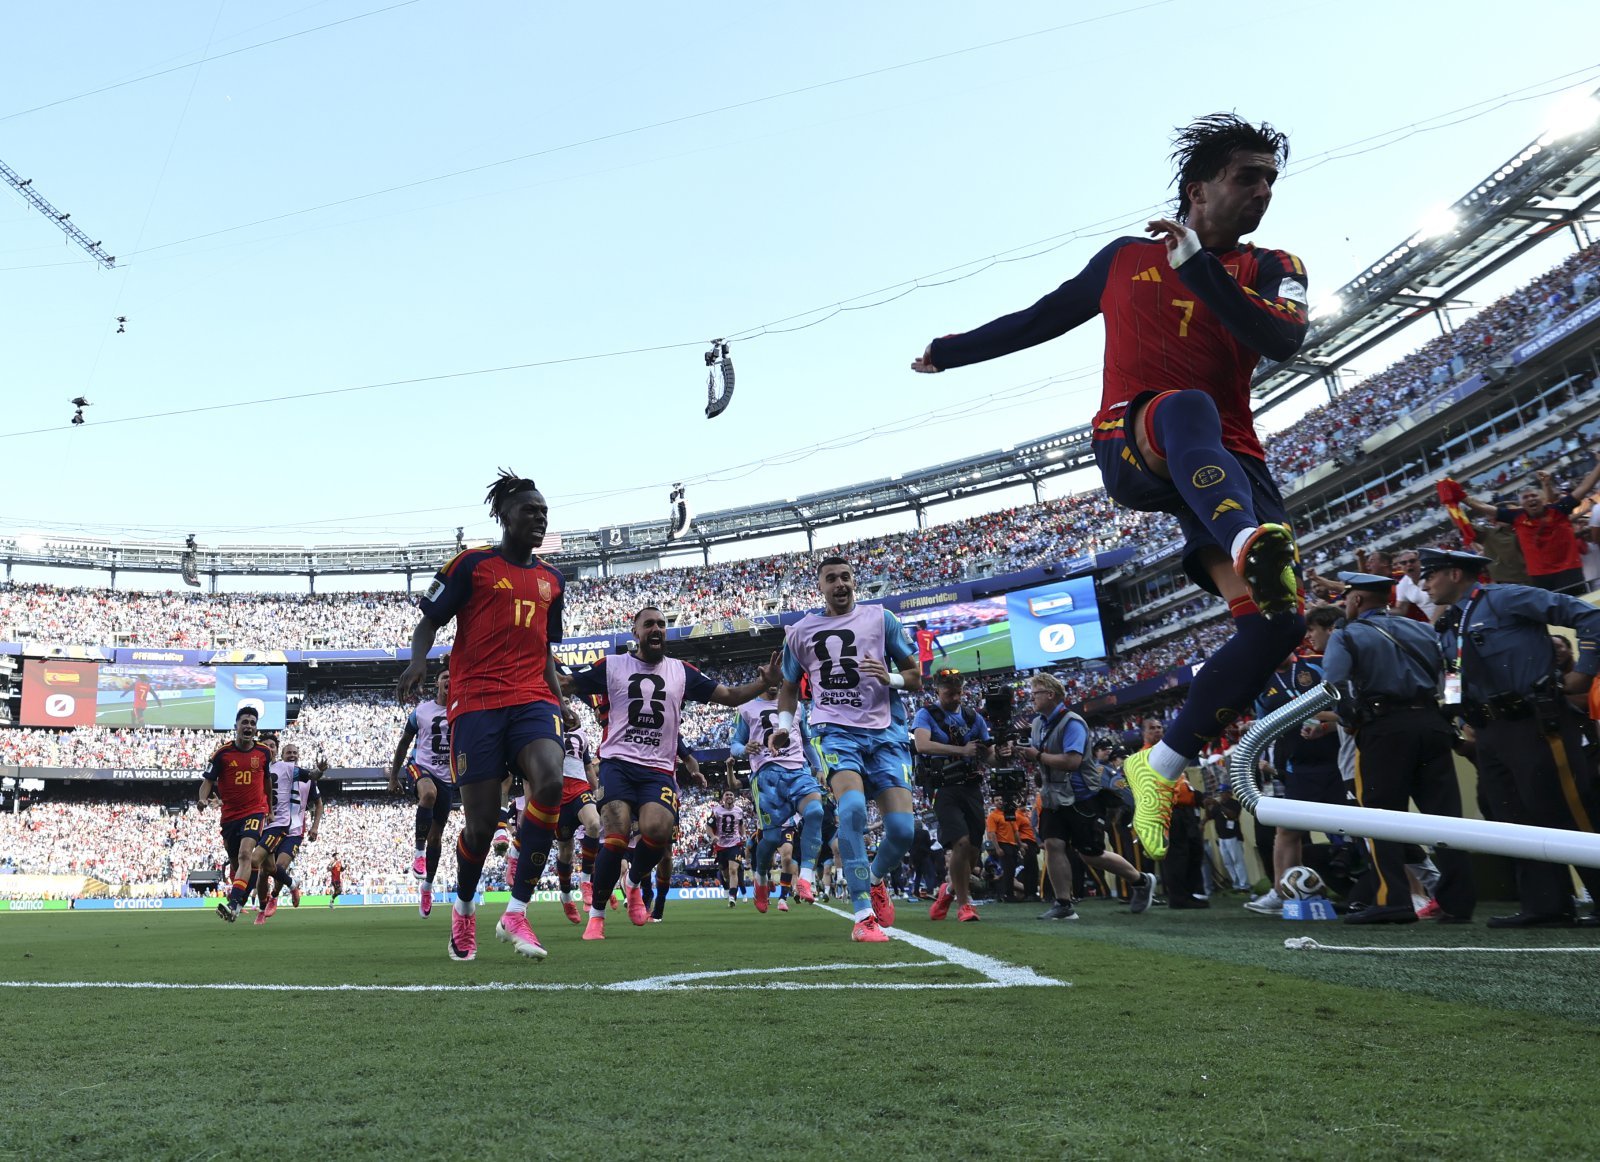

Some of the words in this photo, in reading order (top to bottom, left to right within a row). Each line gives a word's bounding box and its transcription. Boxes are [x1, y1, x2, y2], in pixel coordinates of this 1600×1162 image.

[1171, 299, 1195, 337] 7
[899, 591, 958, 610] #FIFAWorldCup
[514, 599, 536, 628] 17
[559, 644, 578, 652] CUP
[578, 640, 610, 650] 2026
[923, 638, 931, 651] 7
[637, 715, 655, 724] FIFA
[625, 728, 650, 736] WORLD
[624, 734, 660, 747] 2026
[113, 770, 132, 779] FIFA
[134, 770, 165, 779] WORLD
[165, 770, 190, 779] CUP
[235, 770, 252, 785] 20
[244, 819, 260, 831] 20
[265, 835, 276, 847] 11
[9, 900, 43, 909] aramco
[113, 899, 163, 909] aramco
